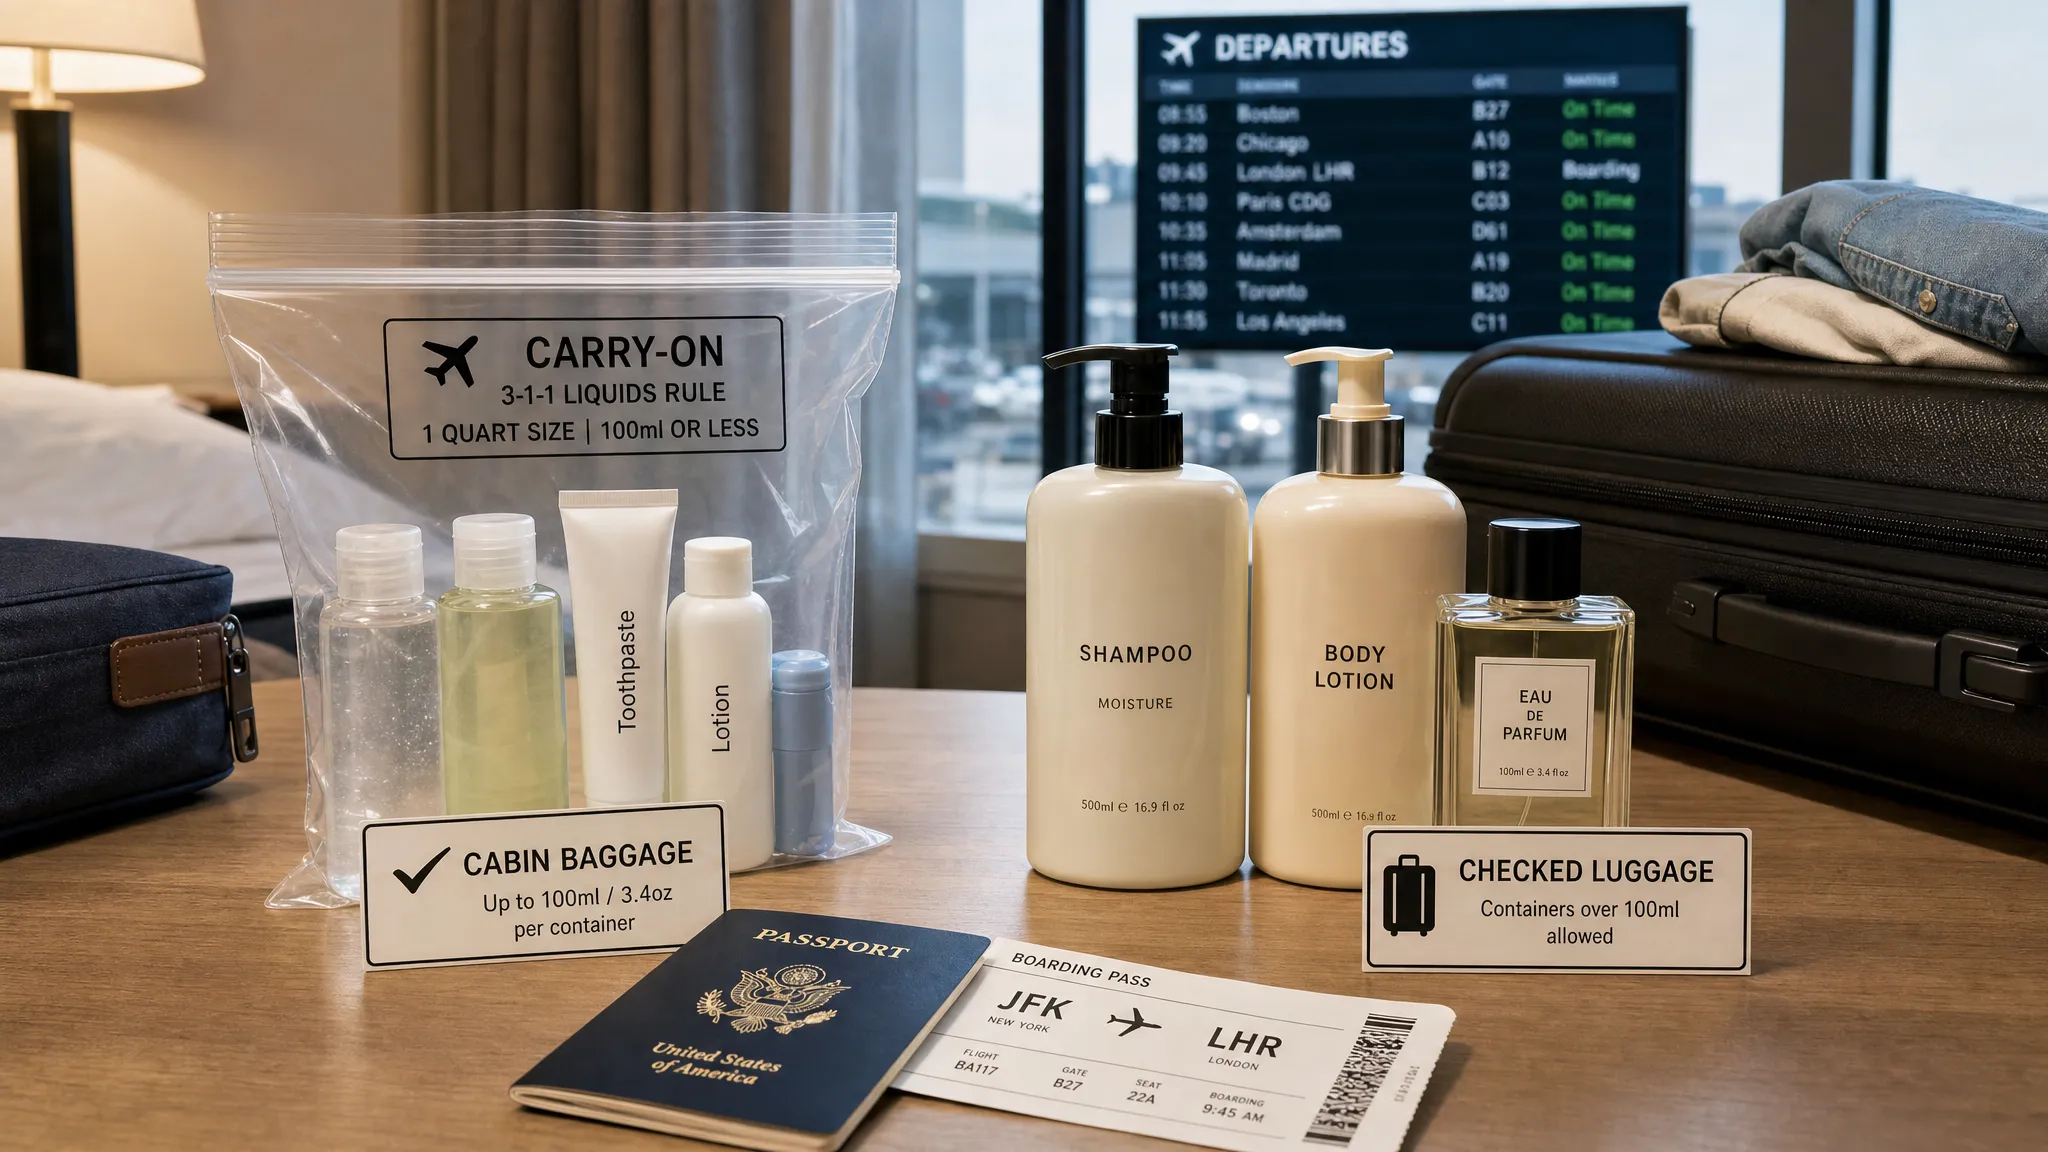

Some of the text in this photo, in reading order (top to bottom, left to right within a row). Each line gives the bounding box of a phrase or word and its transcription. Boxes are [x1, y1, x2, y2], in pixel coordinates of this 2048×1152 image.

[1216, 31, 1408, 61] DEPARTURES
[1237, 104, 1299, 123] Boston
[1473, 100, 1509, 120] B27
[1563, 100, 1635, 118] On Time
[1236, 133, 1309, 156] Chicago
[1472, 131, 1510, 149] A10
[1563, 130, 1635, 148] On Time
[1237, 162, 1354, 182] London LHR
[1473, 161, 1509, 180] B12
[1563, 160, 1640, 183] Boarding
[1159, 193, 1208, 211] 10:10
[1237, 192, 1331, 212] Paris CDG
[1472, 191, 1510, 211] C03
[1562, 191, 1635, 210] On Time
[1237, 222, 1342, 241] Amsterdam
[1472, 222, 1507, 240] D61
[1562, 222, 1634, 240] On Time
[1237, 252, 1299, 271] Madrid
[1472, 252, 1509, 270] A19
[1562, 252, 1634, 270] On Time
[1237, 281, 1308, 301] Toronto
[1472, 282, 1509, 301] B20
[1563, 283, 1634, 301] On Time
[1237, 313, 1346, 335] Los Angeles
[1472, 313, 1507, 332] C11
[1562, 313, 1636, 333] On Time
[527, 335, 723, 368] CARRY-ON
[502, 382, 725, 405] 3-1-1 LIQUIDS RULE
[423, 425, 431, 443] 1
[443, 423, 520, 445] QUART
[528, 422, 575, 441] SIZE
[602, 420, 663, 439] 100ml
[671, 420, 701, 438] OR
[709, 418, 759, 437] LESS
[1081, 645, 1191, 663] SHAMPOO
[1326, 645, 1385, 663] BODY
[616, 610, 640, 734] Toothpaste
[1316, 671, 1393, 689] LOTION
[1098, 698, 1173, 710] MOISTURE
[1519, 690, 1552, 704] EAU
[711, 685, 730, 751] Lotion
[1527, 711, 1544, 722] DE
[1503, 727, 1567, 741] PARFUM
[1499, 768, 1524, 776] 100ml
[1537, 768, 1550, 777] 3.4
[1081, 800, 1114, 812] 500ml
[1134, 802, 1158, 813] 16.9
[1161, 801, 1169, 812] fl
[1172, 803, 1185, 812] oz
[1311, 809, 1340, 820] 500ml
[1356, 812, 1375, 822] 16.9
[464, 840, 693, 876] CABIN BAGGAGE
[1460, 859, 1713, 882] CHECKED LUGGAGE
[484, 894, 509, 916] Up
[515, 894, 535, 910] to
[542, 888, 599, 908] 100ml
[622, 885, 672, 903] 3.4oz
[1481, 900, 1679, 918] Containers over 100ml
[515, 915, 635, 942] per container
[1547, 927, 1612, 944] allowed
[753, 929, 910, 958] PASSPORT
[1011, 952, 1151, 987] BOARDING PASS
[996, 991, 1073, 1021] JFK
[987, 1016, 1051, 1034] NEW YORK
[1207, 1027, 1282, 1059] LHR
[653, 1042, 781, 1074] United States
[962, 1049, 999, 1063] FLIGHT
[1208, 1057, 1260, 1071] LONDON
[651, 1060, 759, 1084] of America
[954, 1059, 998, 1075] BA117
[1061, 1067, 1089, 1077] GATE
[1052, 1078, 1084, 1092] B27
[1135, 1079, 1162, 1090] SEAT
[1126, 1091, 1155, 1105] 22A
[1209, 1092, 1264, 1109] BOARDING
[1201, 1104, 1265, 1123] 9:45 AM
